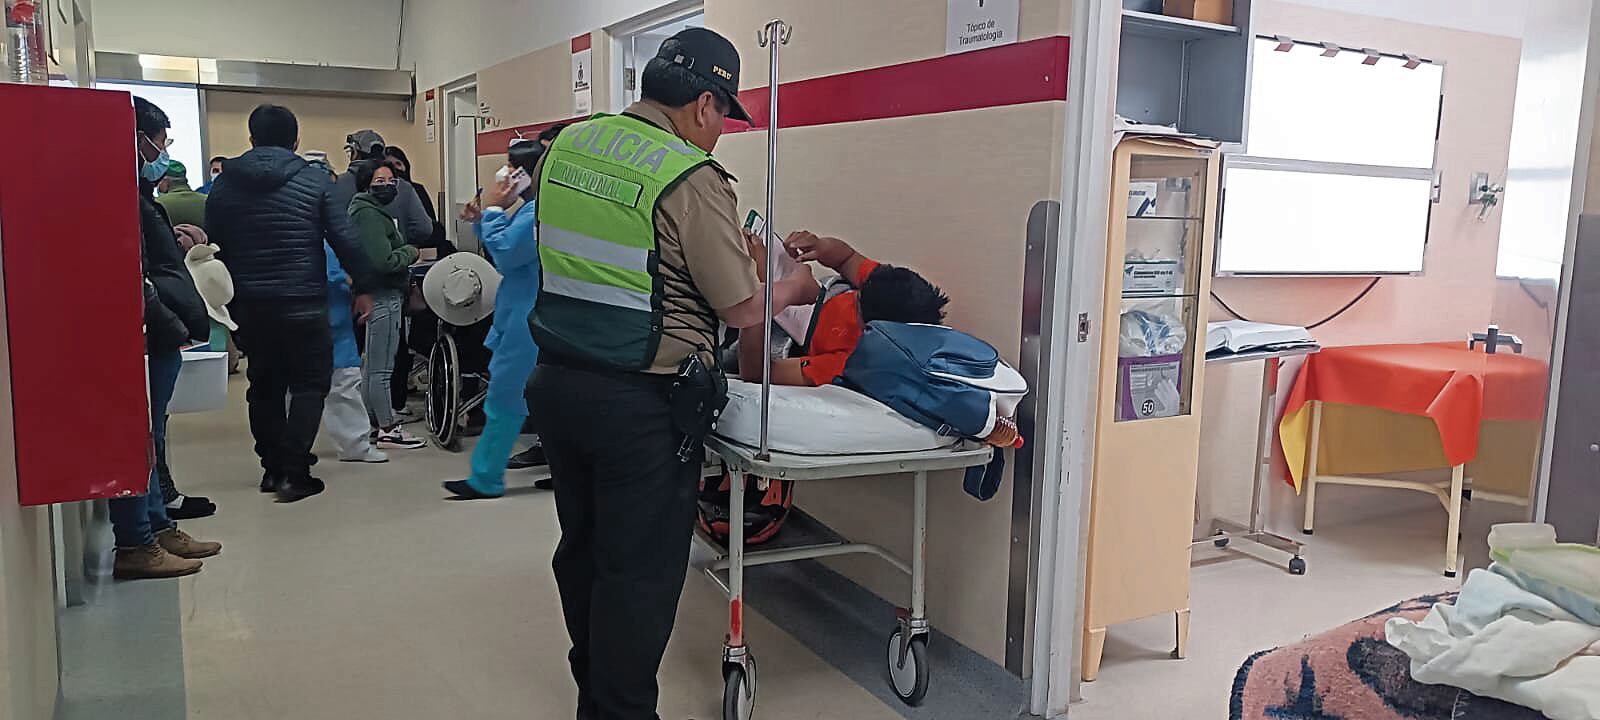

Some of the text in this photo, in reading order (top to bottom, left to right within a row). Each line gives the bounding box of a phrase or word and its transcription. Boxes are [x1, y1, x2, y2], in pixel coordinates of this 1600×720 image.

[987, 19, 995, 29] de
[561, 165, 621, 199] NACIONAL
[1142, 402, 1154, 413] 50
